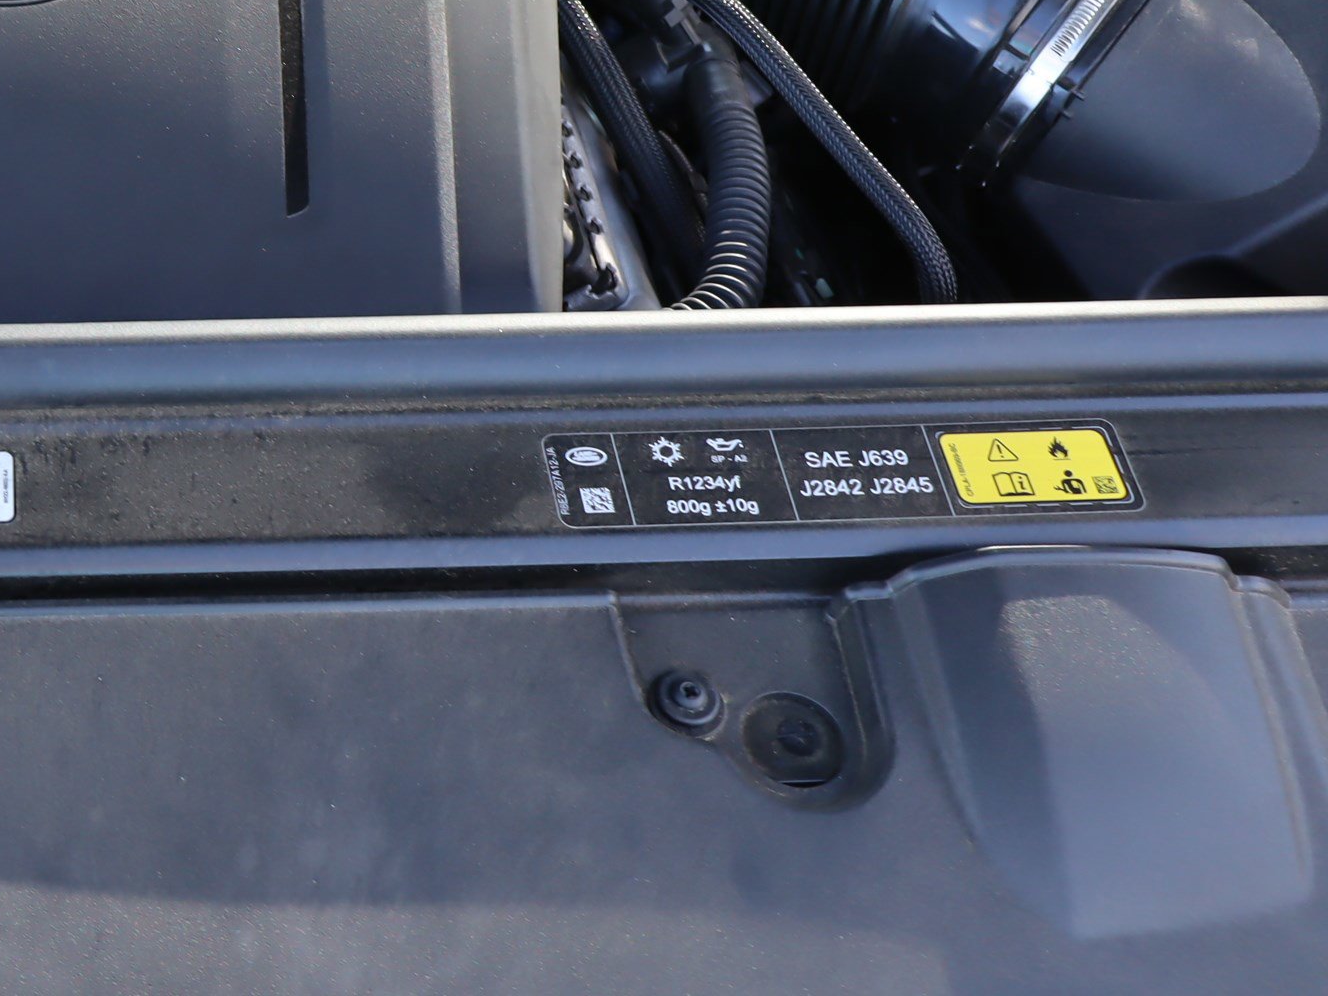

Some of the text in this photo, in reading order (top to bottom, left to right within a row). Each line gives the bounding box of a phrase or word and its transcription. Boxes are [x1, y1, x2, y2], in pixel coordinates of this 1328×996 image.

[804, 449, 909, 468] SAE J639
[668, 475, 741, 492] R1234yf
[800, 476, 934, 497] J2842 J2845
[666, 498, 760, 516] 800g ±10g
